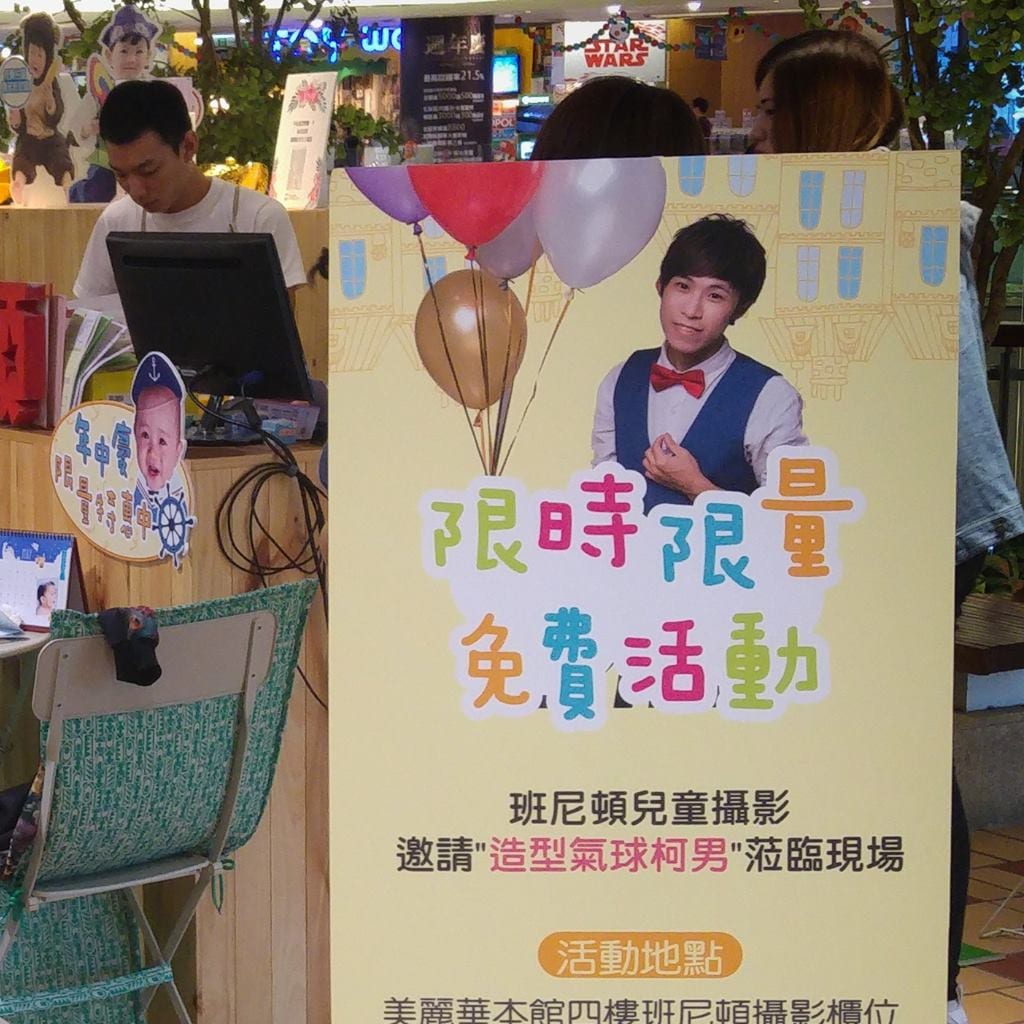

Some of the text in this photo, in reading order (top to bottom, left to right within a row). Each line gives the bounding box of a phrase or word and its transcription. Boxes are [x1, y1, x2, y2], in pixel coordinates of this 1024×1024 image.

[584, 38, 649, 53] STAR
[584, 53, 649, 68] WARS
[75, 412, 132, 478] 年中慶
[430, 457, 854, 590] 限時限量
[461, 606, 818, 721] 免費活動
[508, 788, 791, 828] 班尼頓兒童攝影
[557, 939, 724, 977] 活動地點
